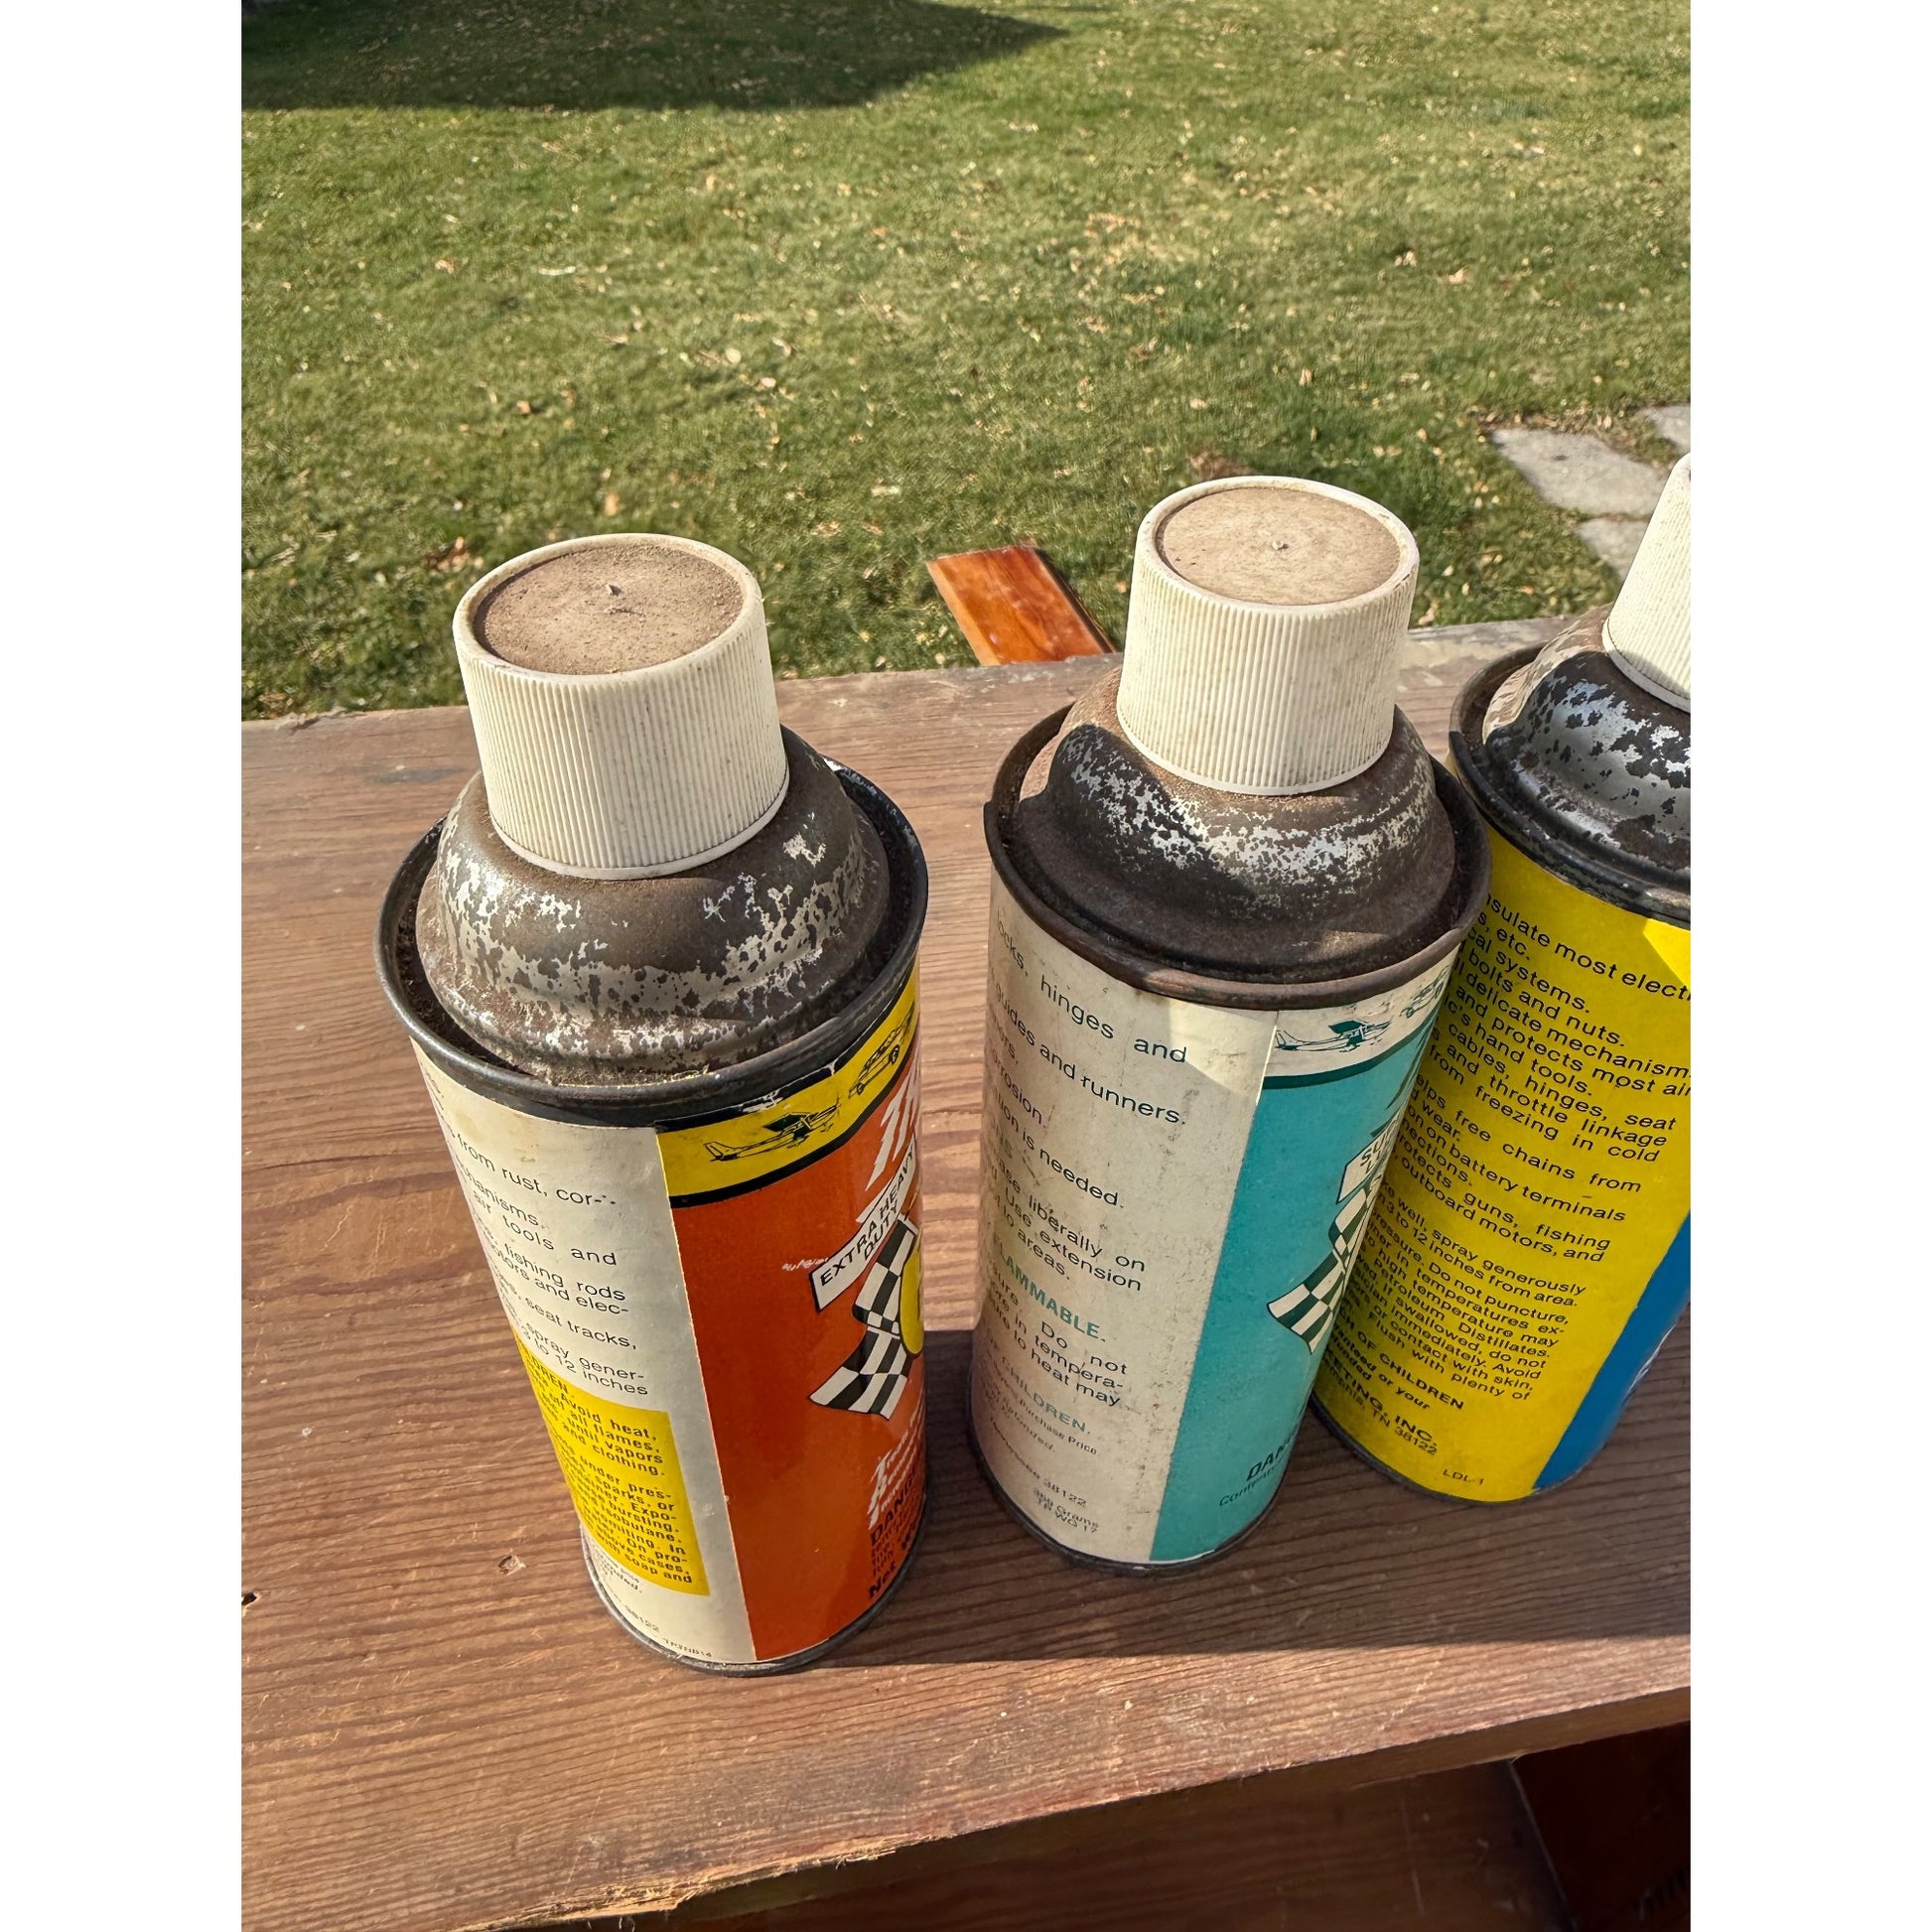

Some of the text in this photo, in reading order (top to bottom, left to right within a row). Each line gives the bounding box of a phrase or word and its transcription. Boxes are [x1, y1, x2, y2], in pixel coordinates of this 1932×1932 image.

[1496, 927, 1531, 961] etc.
[1555, 942, 1617, 979] most
[1469, 948, 1625, 1047] bolts and nuts.
[1496, 951, 1590, 1014] systems.
[1040, 975, 1114, 1039] hinges
[1133, 1038, 1187, 1063] and
[1456, 985, 1656, 1093] and protects most
[1466, 972, 1691, 1080] delicate mechanism
[996, 983, 1035, 1046] guides
[1039, 1043, 1075, 1080] and
[1080, 1075, 1186, 1125] runners.
[1449, 1023, 1677, 1131] cables, hinges, seat
[1475, 1023, 1525, 1063] hand
[1530, 1058, 1592, 1096] tools.
[1422, 1100, 1461, 1143] wear.
[1430, 1044, 1661, 1163] from freezing in cold
[1447, 1044, 1668, 1147] and throttle linkage
[457, 1133, 496, 1173] from
[501, 1168, 548, 1197] rust,
[1023, 1128, 1035, 1151] is
[1039, 1147, 1125, 1209] needed.
[1427, 1126, 1626, 1222] on battery terminals
[1455, 1109, 1641, 1192] free chains from
[502, 1214, 555, 1251] tools
[571, 1247, 618, 1266] and
[820, 1220, 878, 1288] EXTRA
[879, 1145, 914, 1218] HEAVY
[863, 1199, 898, 1262] DUTY
[1005, 1186, 1142, 1292] Use extension
[1029, 1194, 1145, 1272] liberally on
[1402, 1157, 1605, 1263] outboard motors, and
[1462, 1191, 1611, 1251] guns, fishing
[504, 1242, 564, 1288] fishing
[576, 1281, 626, 1302] rods
[1003, 1205, 1070, 1281] to areas.
[1396, 1212, 1409, 1229] to
[1413, 1227, 1428, 1245] 12
[1429, 1240, 1485, 1280] inches
[1488, 1275, 1531, 1299] from
[1533, 1293, 1578, 1307] area.
[1398, 1197, 1587, 1296] well, spray generously
[524, 1297, 563, 1327] seat
[567, 1319, 636, 1350] tracks,
[534, 1277, 570, 1302] and
[576, 1296, 628, 1315] elec-
[1373, 1258, 1446, 1321] Petroleum
[1457, 1321, 1550, 1358] Distillates.
[1378, 1248, 1408, 1281] high
[1412, 1280, 1514, 1338] temperature
[1520, 1333, 1560, 1348] may
[1396, 1250, 1566, 1335] in temperatures ex-
[1429, 1262, 1569, 1325] Do not puncture,
[525, 1322, 644, 1380] spray gener-
[1015, 1312, 1124, 1389] in tempera-
[1041, 1320, 1128, 1375] Do not
[1368, 1311, 1531, 1401] Flush with plenty of
[1374, 1305, 1534, 1391] or contact with skin,
[1391, 1306, 1542, 1379] immediately. Avoid
[1395, 1297, 1482, 1355] swallowed,
[1488, 1350, 1512, 1362] do
[1517, 1357, 1547, 1369] not
[534, 1337, 648, 1396] to 12 inches
[1002, 1355, 1092, 1436] CHILDREN.
[1014, 1329, 1121, 1407] to heat may
[1357, 1330, 1378, 1350] OF
[1379, 1352, 1464, 1410] CHILDREN
[1378, 1373, 1431, 1410] or your
[560, 1392, 602, 1424] Avoid
[610, 1418, 657, 1442] heat,
[563, 1421, 588, 1446] and
[592, 1444, 666, 1476] clothing.
[567, 1417, 600, 1444] until
[605, 1441, 663, 1464] vapors
[570, 1410, 589, 1427] all
[594, 1424, 660, 1453] flames,
[1372, 1409, 1438, 1456] TN 38122
[1394, 1414, 1438, 1447] INC.
[580, 1454, 621, 1485] under
[628, 1482, 672, 1500] pres-
[595, 1475, 651, 1508] sparks,
[657, 1500, 675, 1511] or
[602, 1506, 683, 1544] isobutane.
[609, 1500, 680, 1533] bursting.
[630, 1501, 677, 1521] Expo-
[624, 1553, 658, 1576] soap
[663, 1571, 694, 1585] and
[626, 1538, 688, 1564] On pro-
[638, 1554, 690, 1575] cases,
[669, 1543, 686, 1556] In
